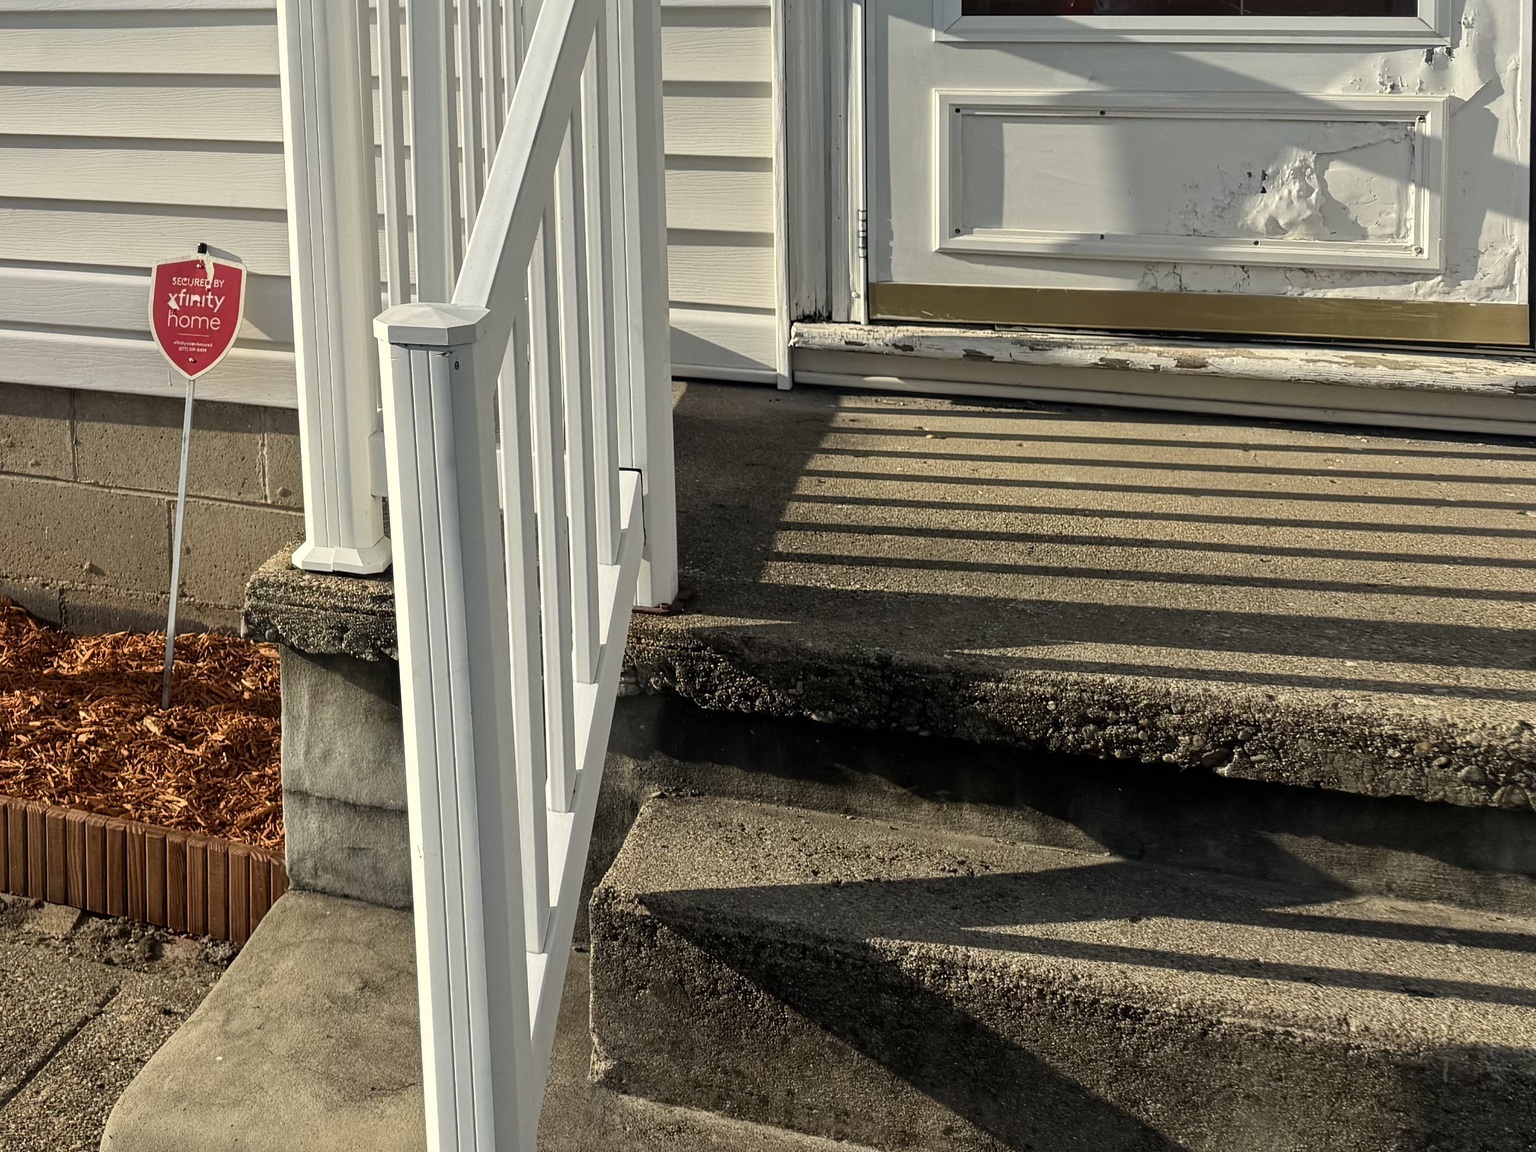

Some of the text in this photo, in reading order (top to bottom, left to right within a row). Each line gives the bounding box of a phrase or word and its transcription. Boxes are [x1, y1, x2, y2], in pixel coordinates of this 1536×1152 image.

[172, 277, 225, 288] SECURED BY
[167, 289, 225, 313] xfinity
[167, 309, 221, 330] home
